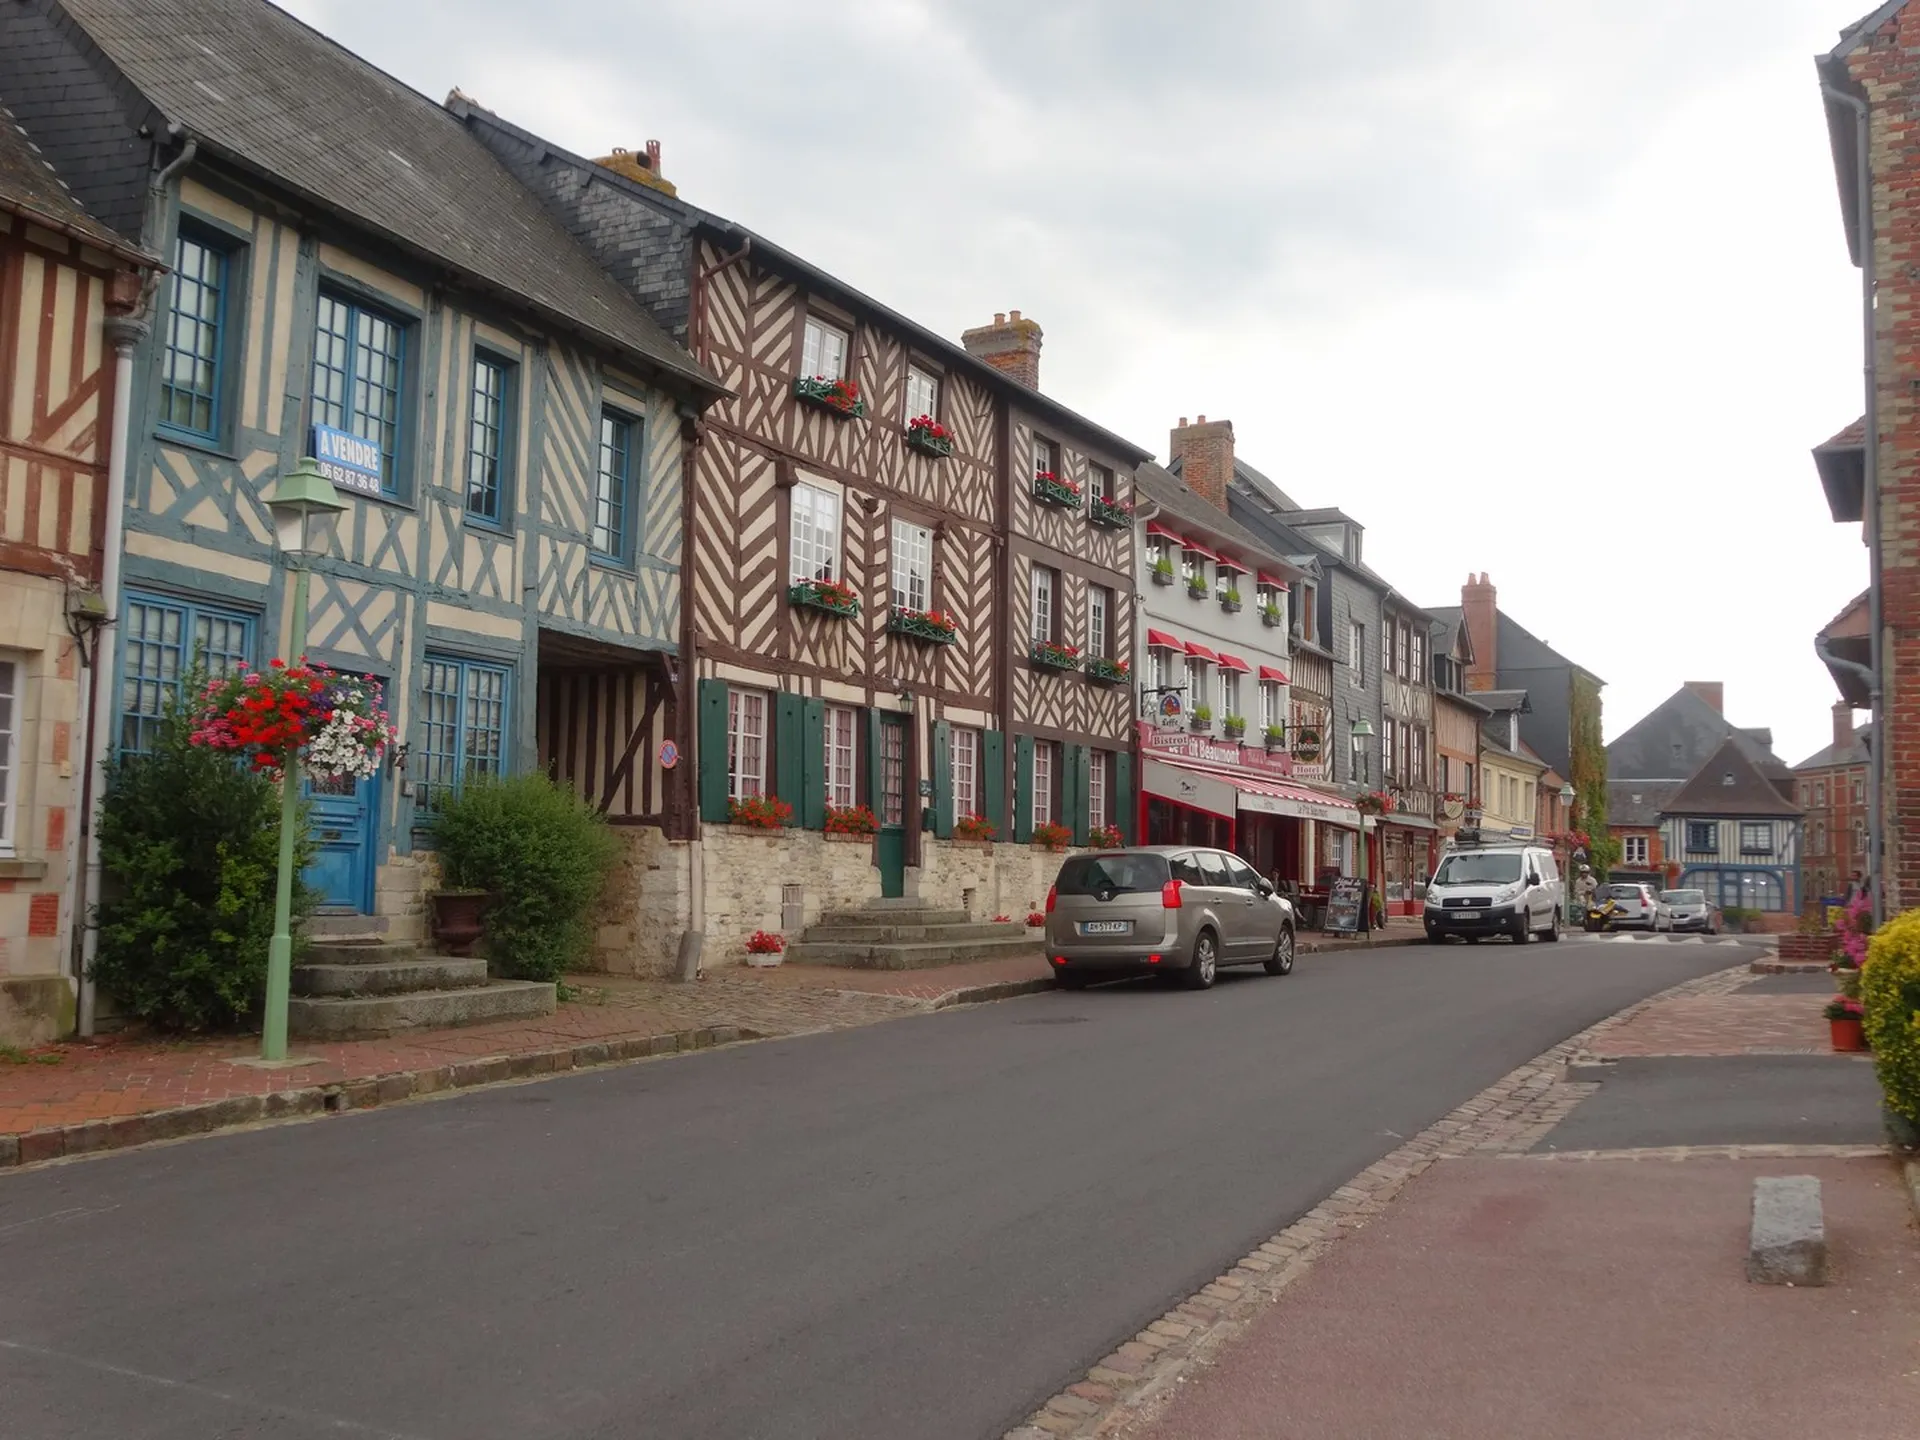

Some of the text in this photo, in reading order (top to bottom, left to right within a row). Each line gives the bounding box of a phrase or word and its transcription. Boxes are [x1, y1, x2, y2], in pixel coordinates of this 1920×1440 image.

[320, 430, 378, 471] A VENDRE
[332, 466, 345, 482] 62
[1154, 735, 1188, 745] Bistrot
[1199, 739, 1240, 765] Beaumont
